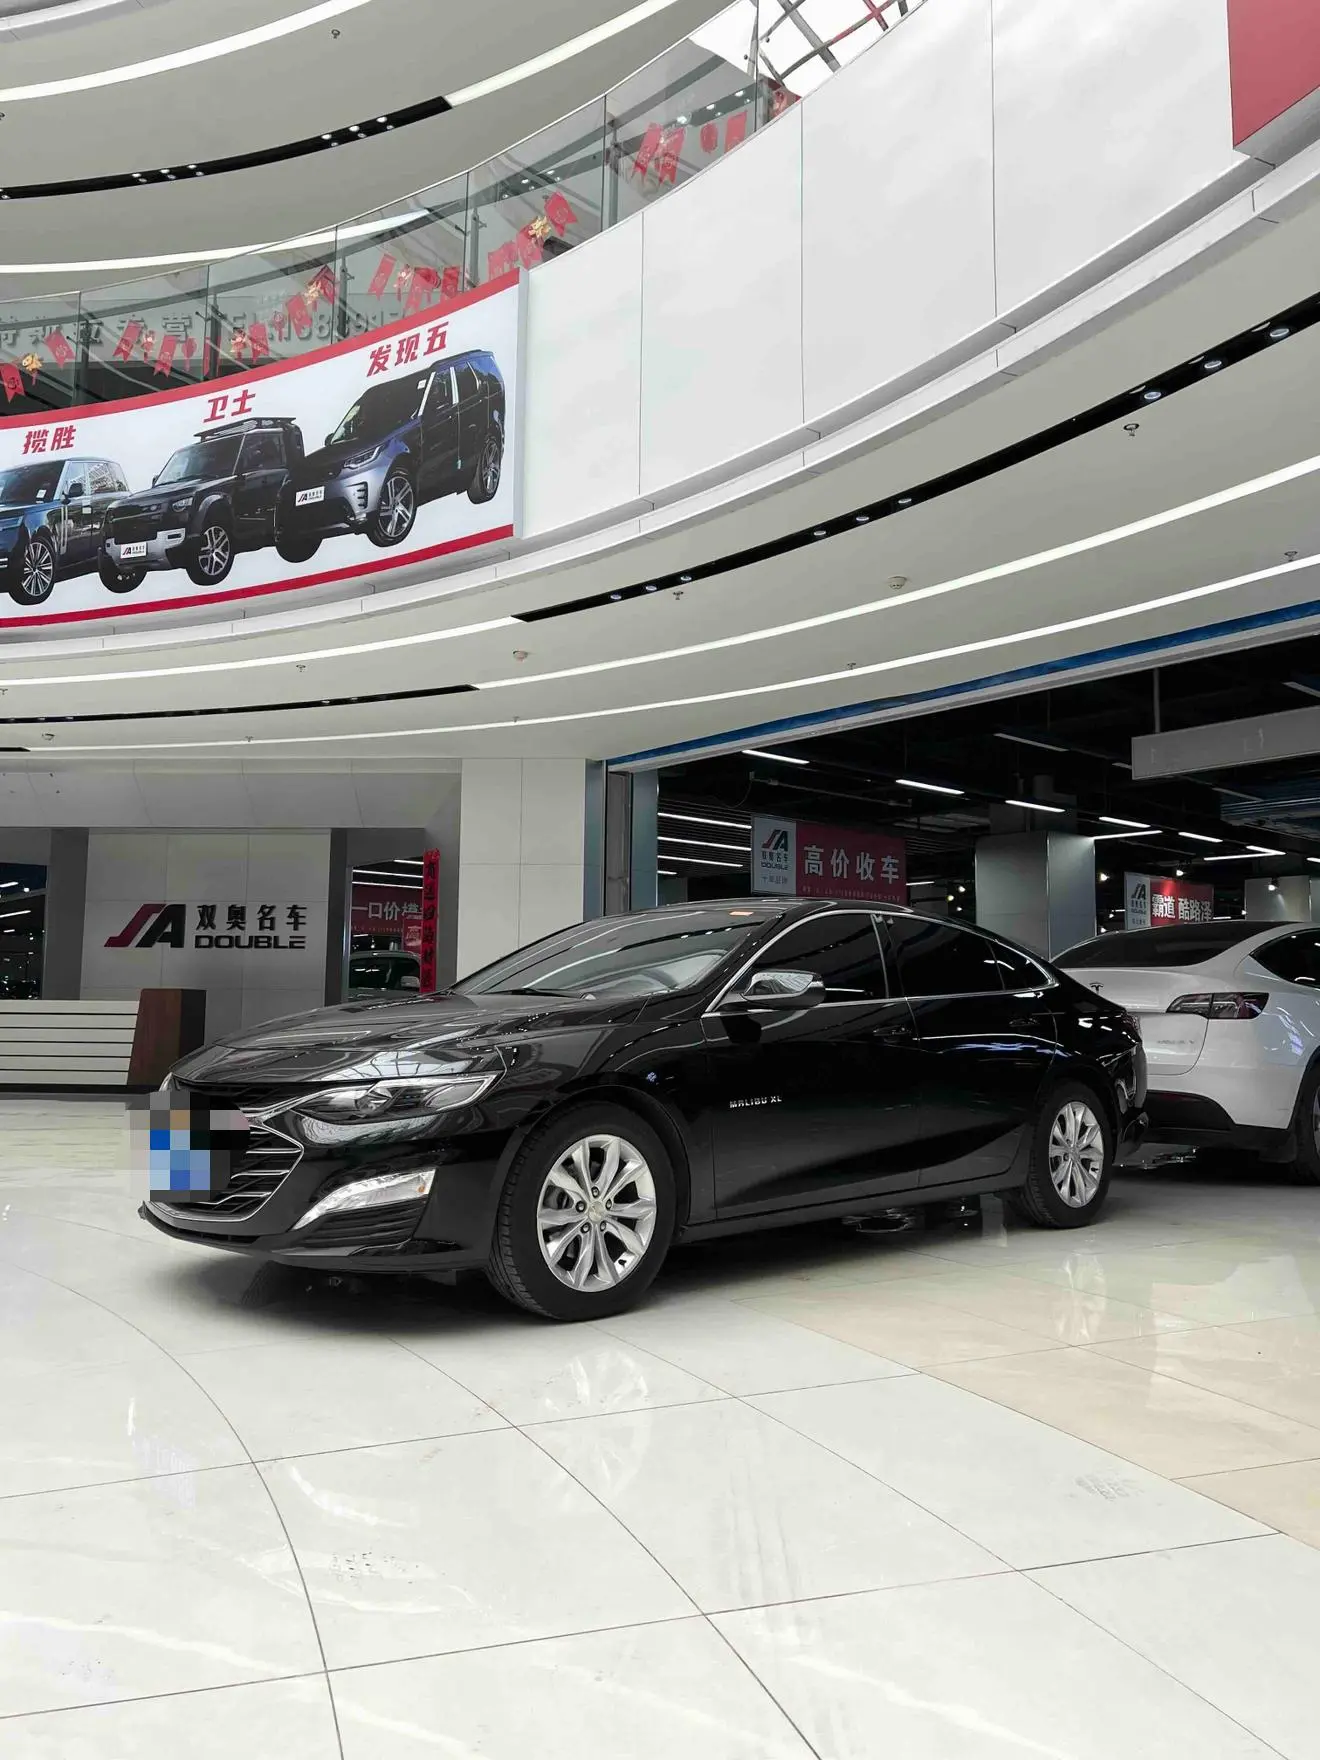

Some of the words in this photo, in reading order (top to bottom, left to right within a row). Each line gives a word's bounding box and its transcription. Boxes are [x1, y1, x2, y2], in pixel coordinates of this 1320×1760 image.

[366, 321, 449, 377] 发现五
[203, 389, 256, 423] 卫士
[22, 425, 76, 454] 揽胜
[803, 844, 900, 884] 高价收车
[196, 904, 308, 931] 双奥名车
[1152, 894, 1176, 918] 霸道
[1178, 897, 1212, 922] 酷路泽
[194, 935, 307, 949] DOUBLE
[729, 1097, 767, 1108] MALIBU
[770, 1095, 782, 1103] XL
